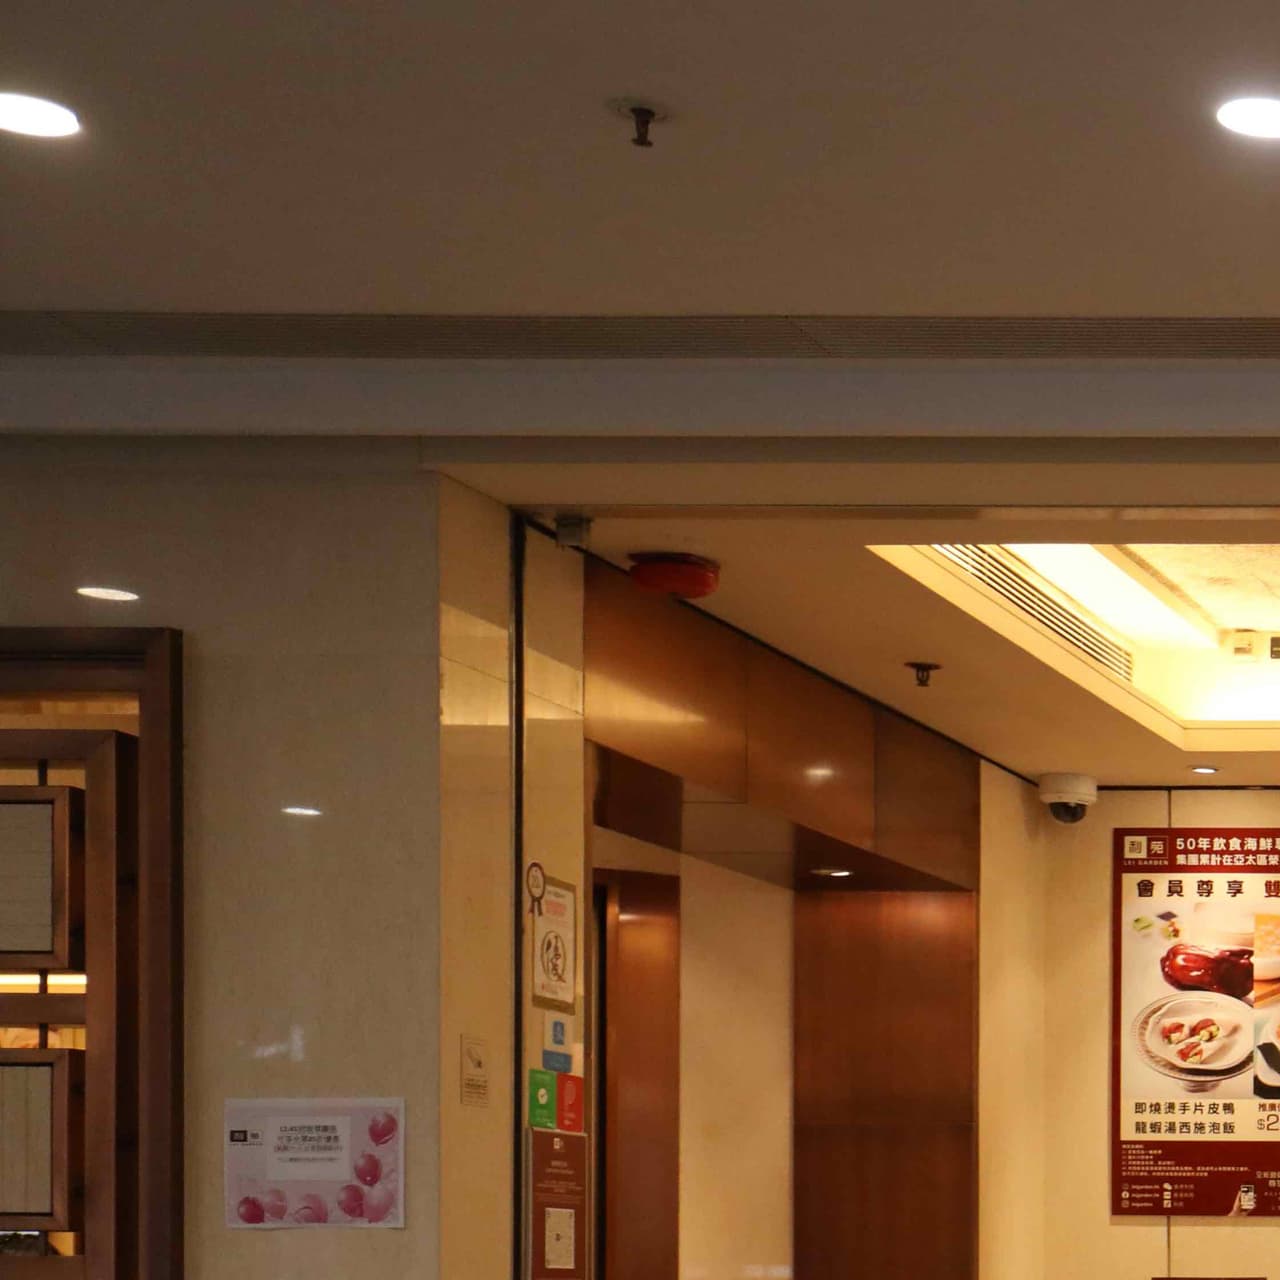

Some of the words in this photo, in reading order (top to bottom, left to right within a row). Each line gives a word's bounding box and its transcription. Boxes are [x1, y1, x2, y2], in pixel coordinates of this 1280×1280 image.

[1137, 880, 1244, 897] 會員尊享
[1135, 1121, 1236, 1134] 龍蝦湯西施泡飯
